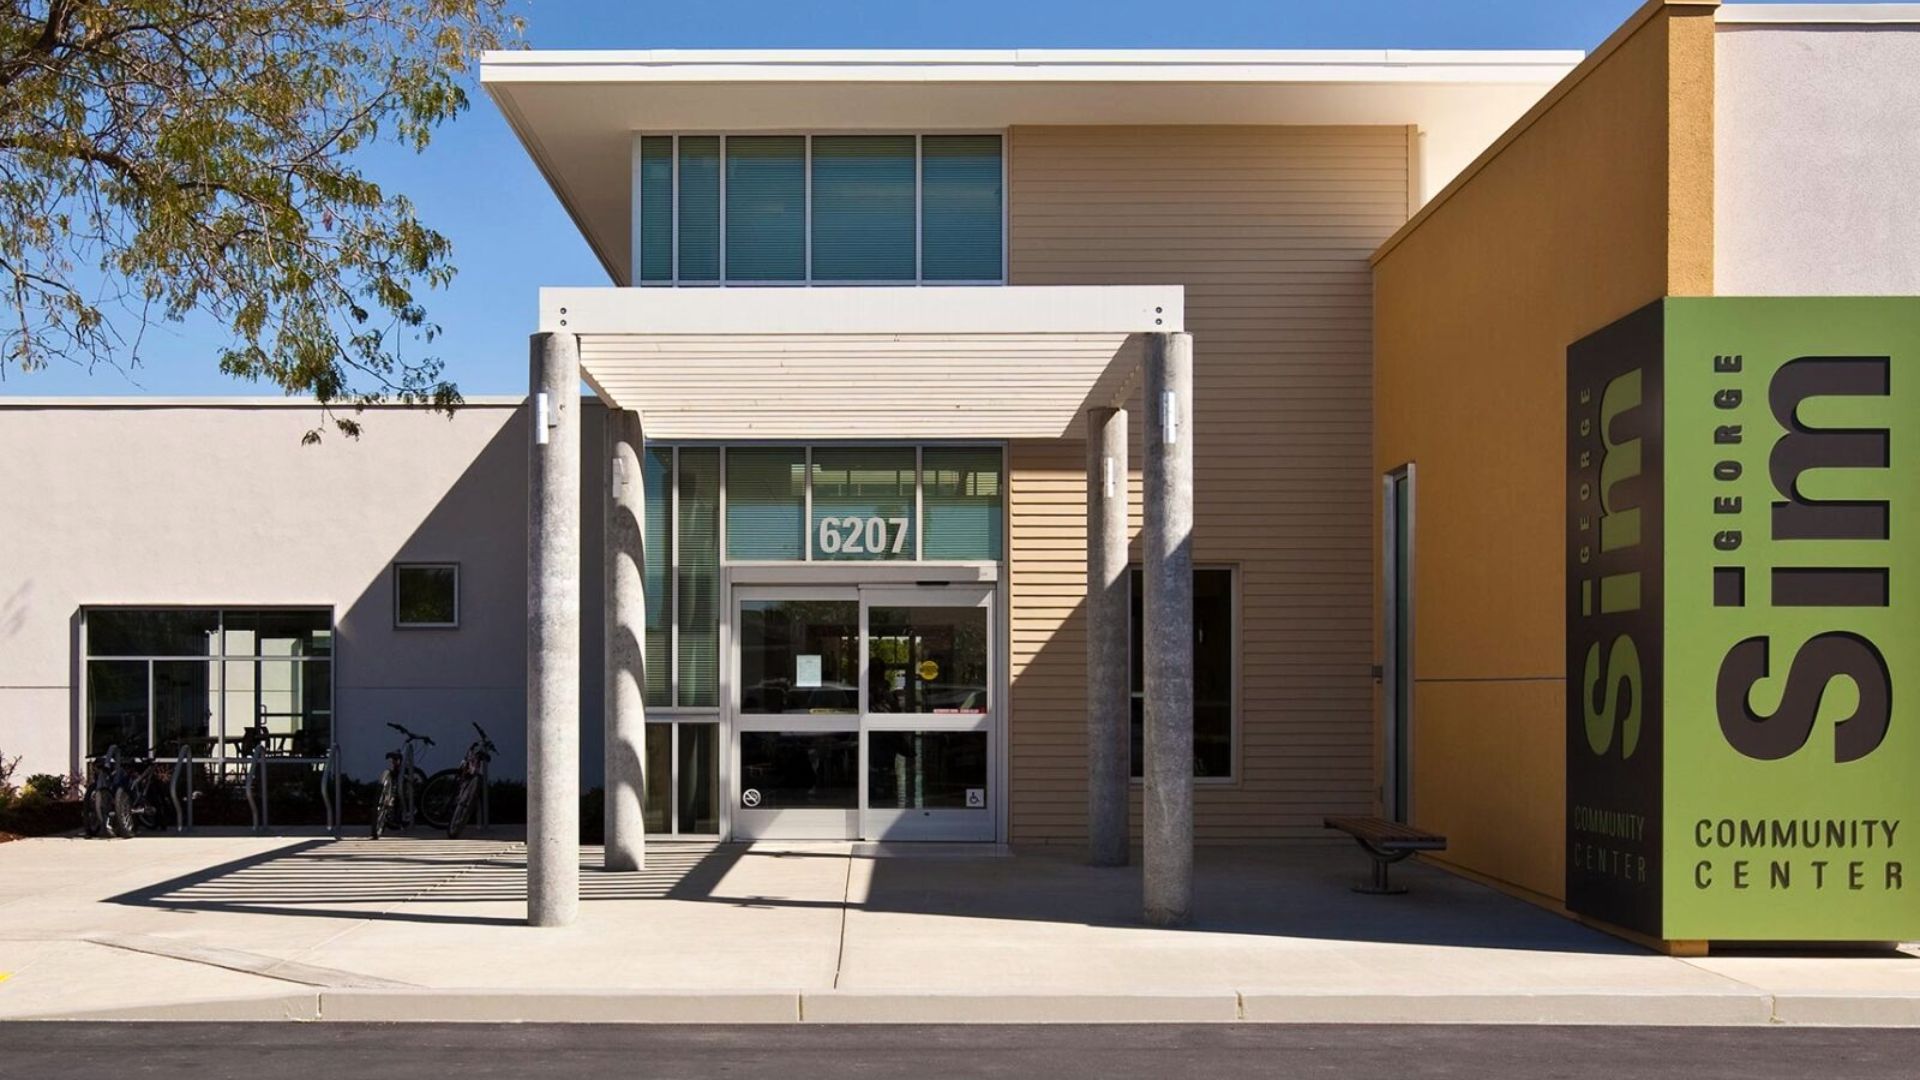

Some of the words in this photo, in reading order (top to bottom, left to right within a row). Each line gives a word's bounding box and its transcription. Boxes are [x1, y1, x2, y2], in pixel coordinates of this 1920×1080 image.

[1713, 355, 1743, 551] GEORGE
[1580, 387, 1591, 564] GEORGE
[819, 517, 909, 553] 6207
[1582, 367, 1643, 761] Sim
[1713, 355, 1893, 764] Sim
[1575, 805, 1645, 842] COMMUNITY
[1695, 819, 1900, 848] COMMUNITY
[1575, 843, 1646, 882] CENTER
[1694, 860, 1903, 890] CENTER
